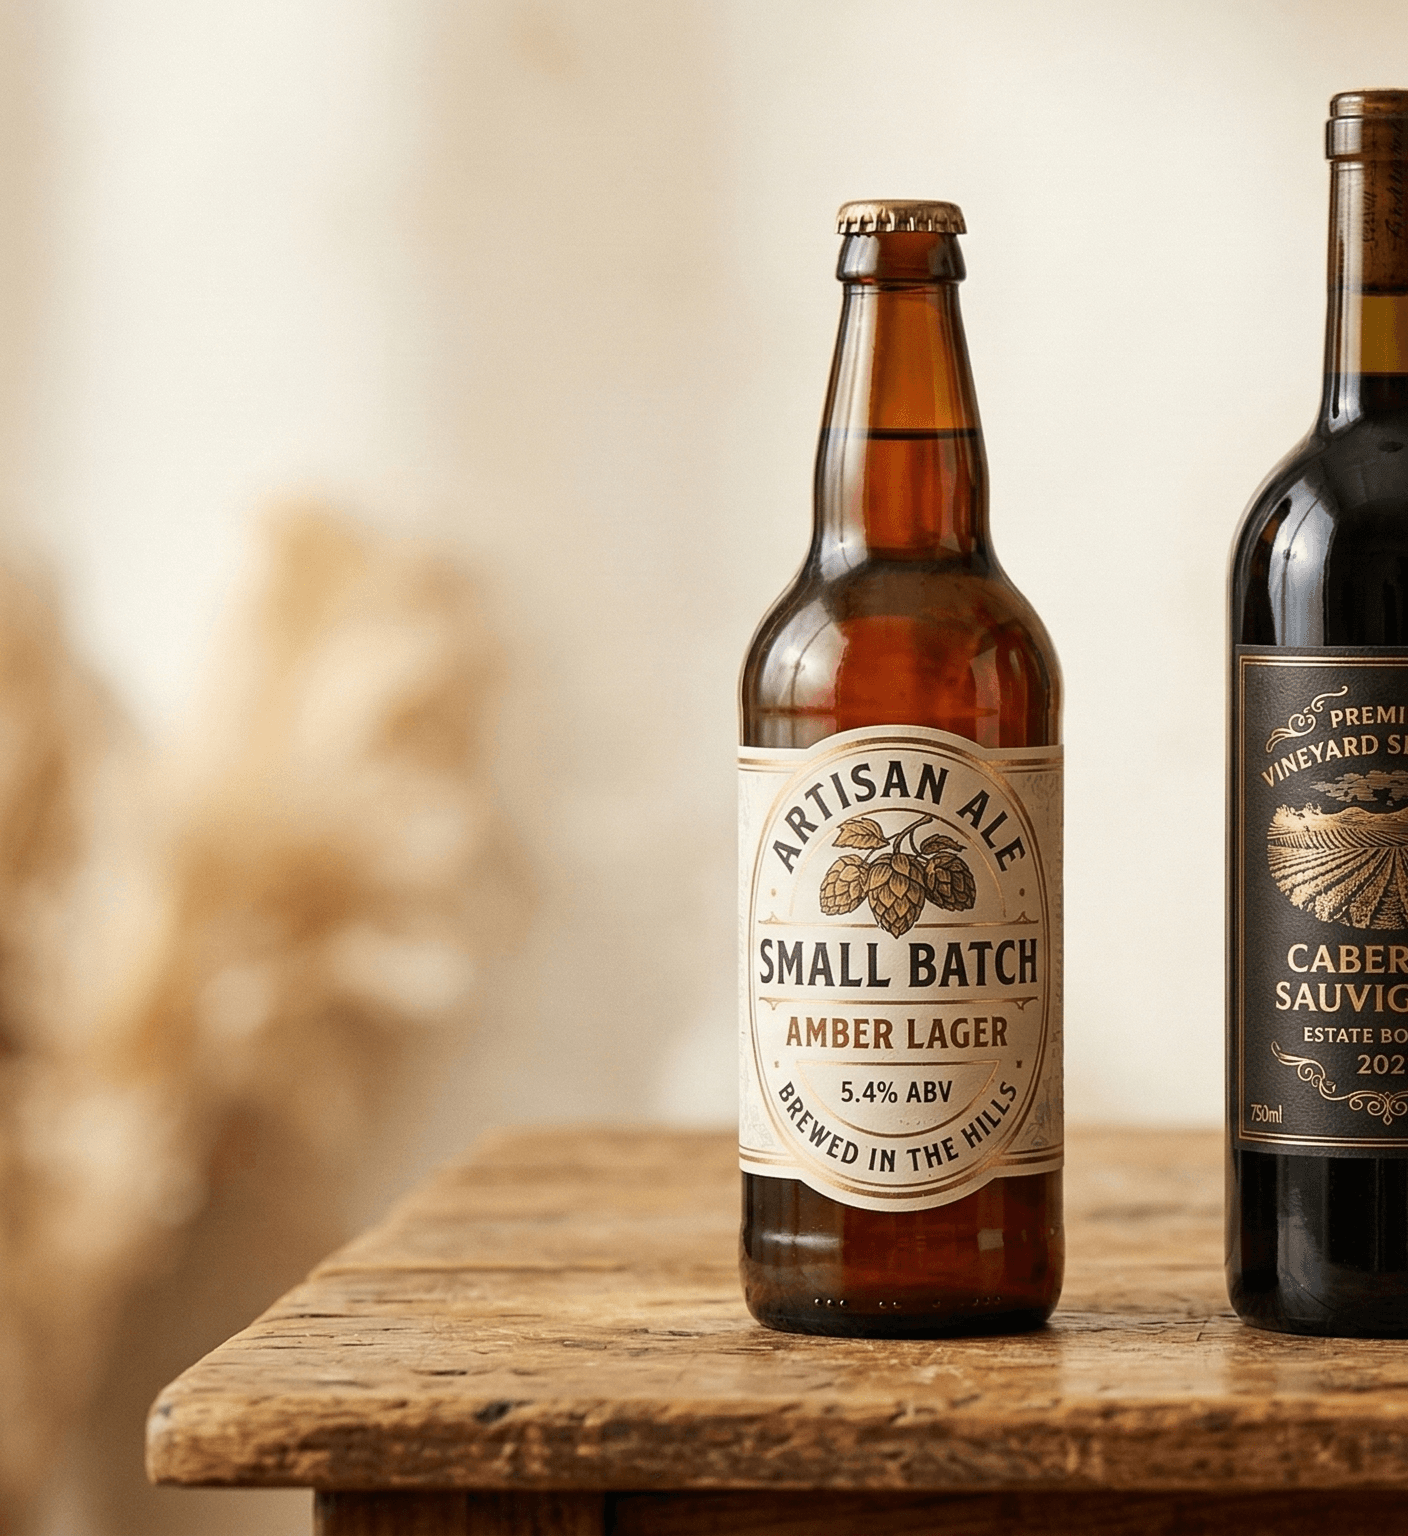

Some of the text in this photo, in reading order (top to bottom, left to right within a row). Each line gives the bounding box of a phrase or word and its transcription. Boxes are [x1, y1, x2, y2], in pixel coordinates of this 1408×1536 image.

[1261, 735, 1379, 787] VINEYARD
[772, 761, 1026, 873] ARTISAN ALE
[759, 939, 1038, 987] SMALL BATCH
[786, 1016, 1007, 1048] AMBER LAGER
[1304, 1027, 1373, 1043] ESTATE
[841, 1081, 952, 1103] 5.4% ABV
[779, 1081, 1018, 1172] BREWED IN THE HILLS
[1251, 1104, 1282, 1123] 750ml
